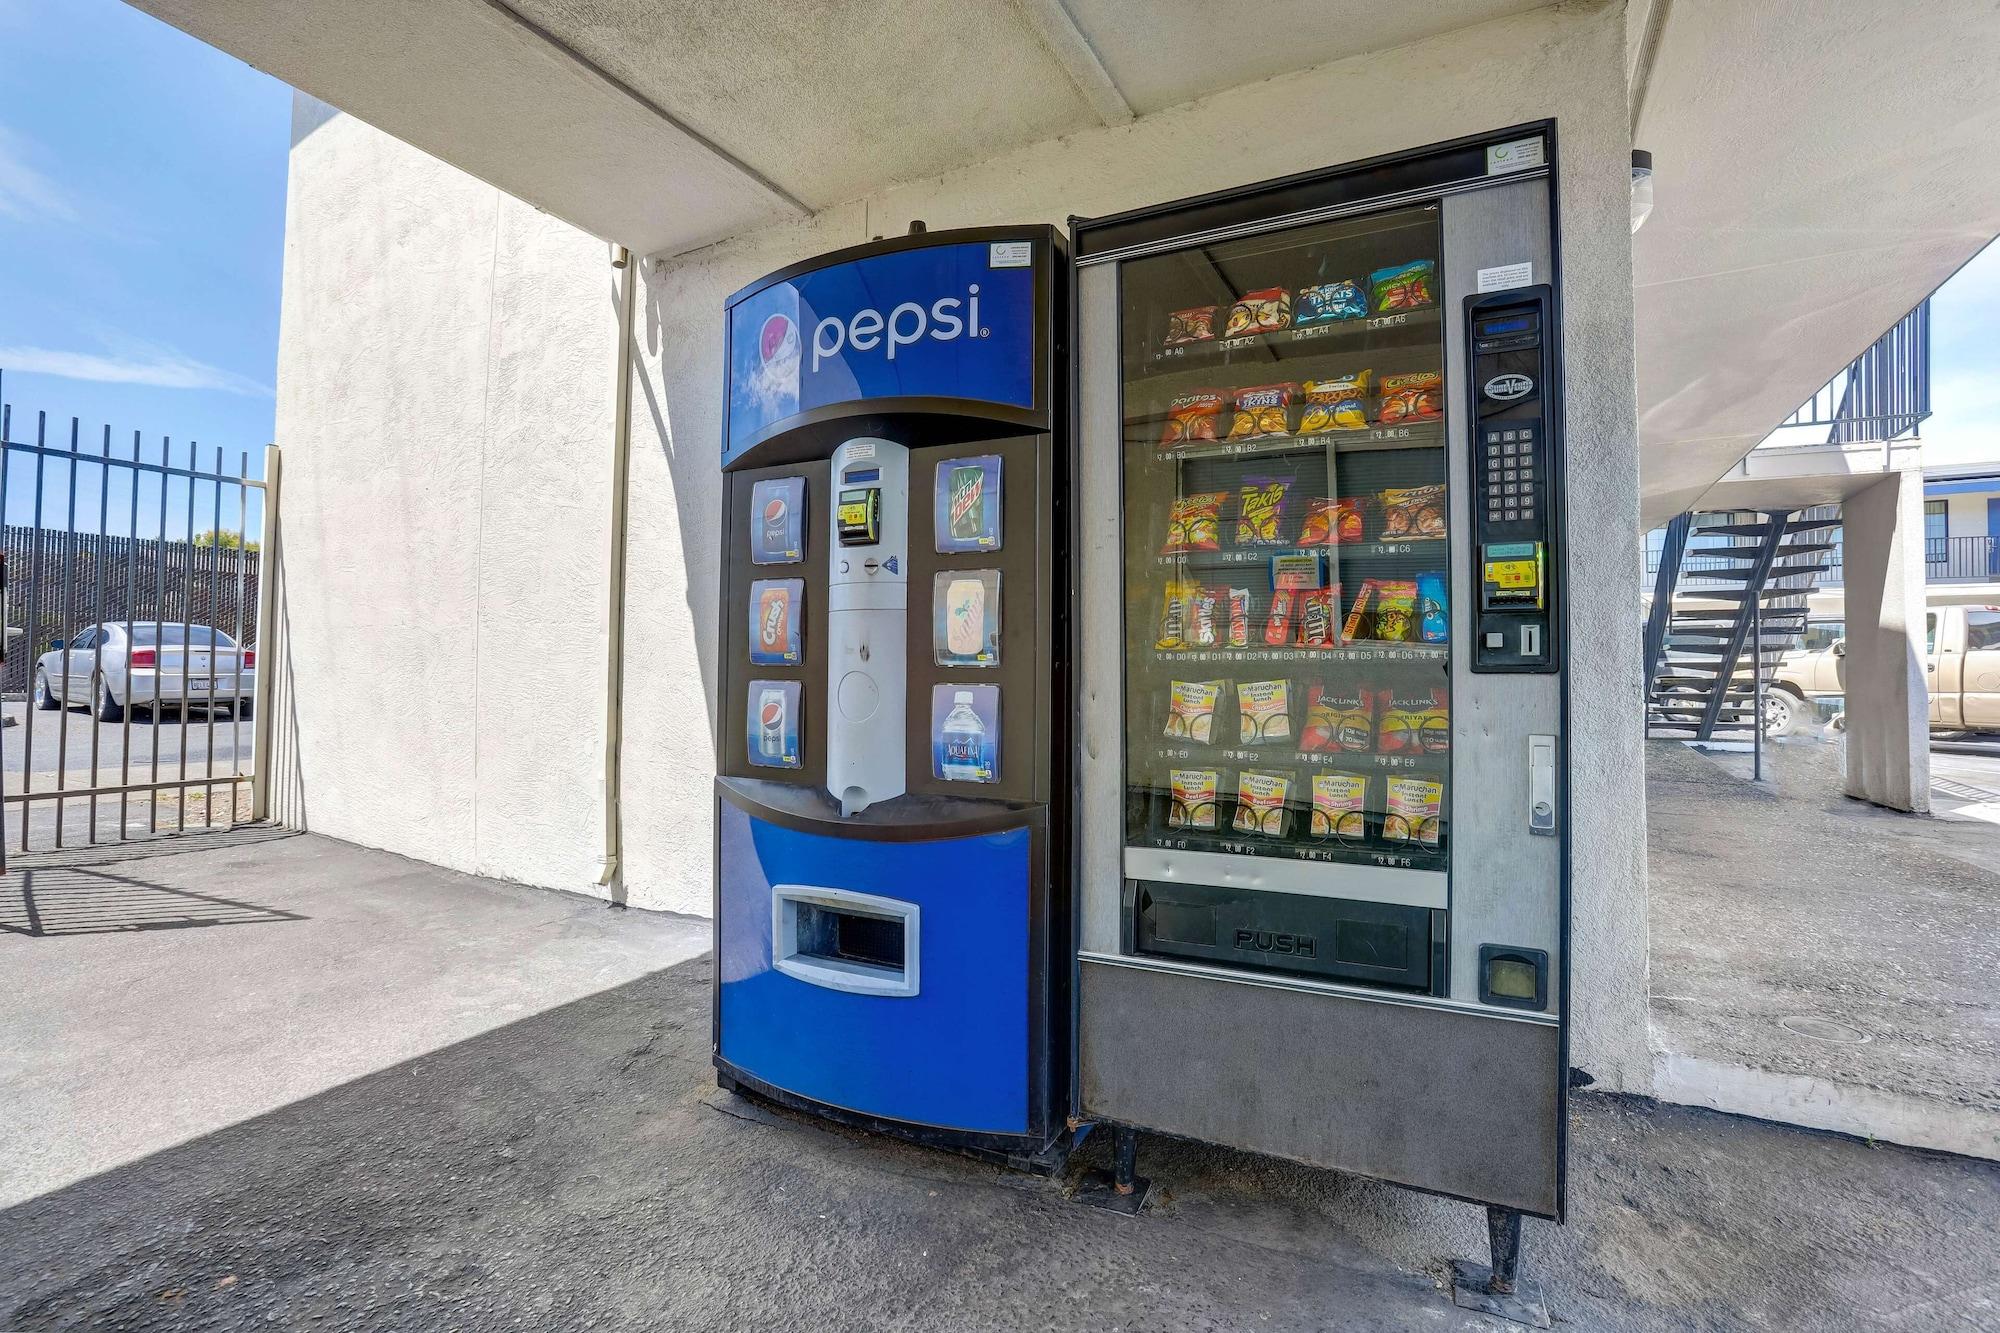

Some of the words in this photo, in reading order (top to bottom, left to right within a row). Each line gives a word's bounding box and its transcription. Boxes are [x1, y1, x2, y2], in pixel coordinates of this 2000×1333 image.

[812, 283, 981, 373] pepsi
[762, 600, 784, 646] Crush
[1180, 686, 1213, 696] Maruchan
[1247, 684, 1282, 692] Maruchan
[1180, 773, 1212, 781] Maruchan
[1249, 776, 1283, 788] Maruchan
[1324, 780, 1360, 788] Maruchan
[1400, 784, 1437, 794] Maruchan
[1235, 930, 1316, 958] PUSH
